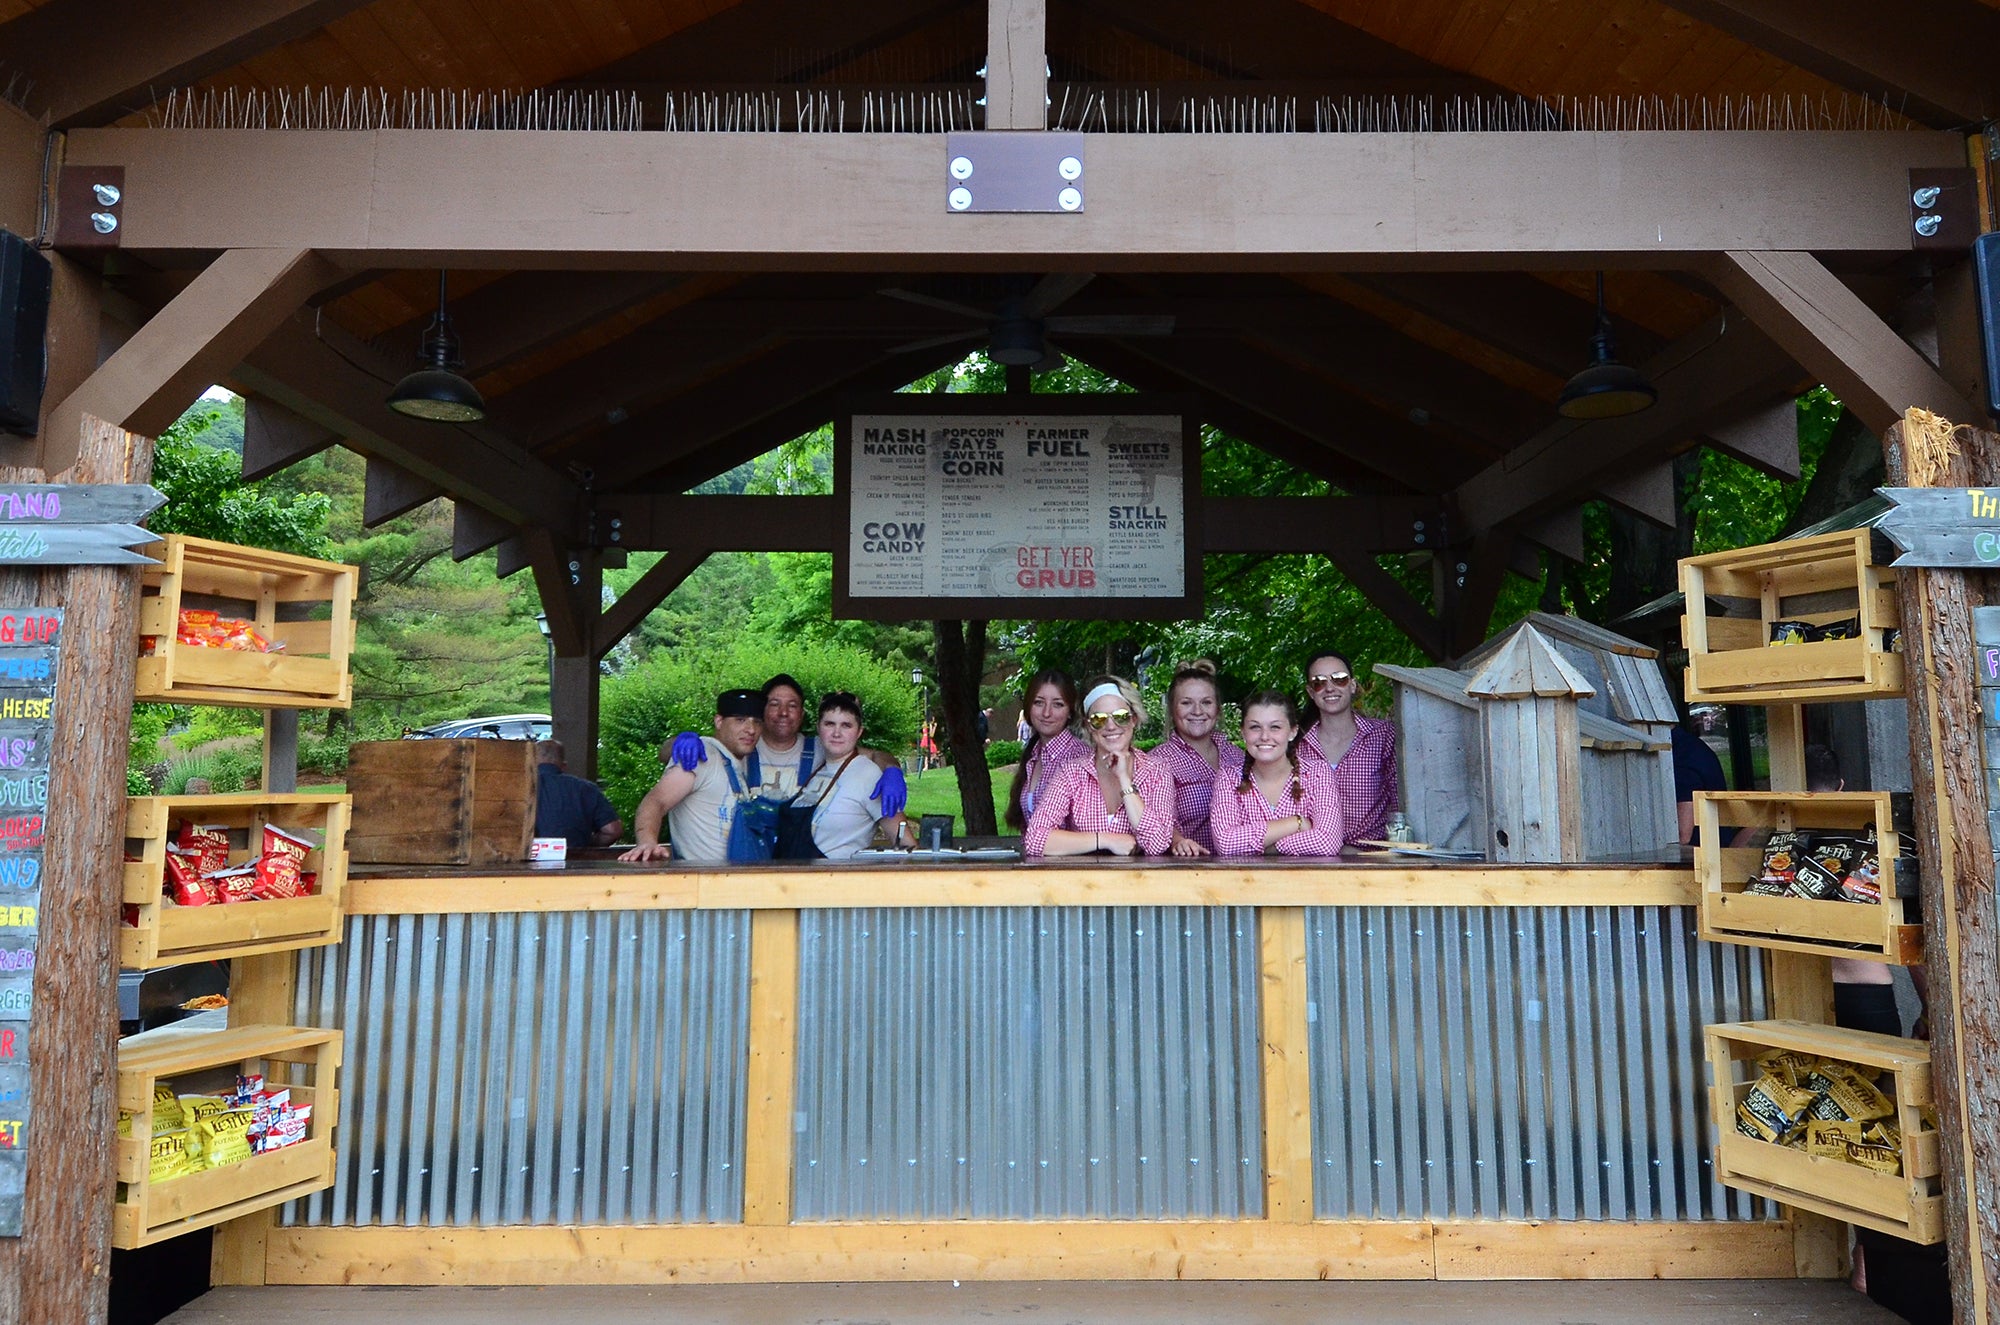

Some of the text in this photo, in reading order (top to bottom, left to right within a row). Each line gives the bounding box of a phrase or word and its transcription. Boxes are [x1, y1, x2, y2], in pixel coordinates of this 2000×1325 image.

[864, 428, 926, 443] MASH
[942, 428, 1004, 437] POPCORN
[1027, 429, 1089, 439] FARMER
[864, 444, 926, 455] MAKING
[950, 438, 997, 450] SAYS
[1027, 441, 1090, 457] FUEL
[1108, 443, 1170, 453] SWEETS
[943, 451, 1004, 460] SAVE THE
[942, 461, 1004, 476] CORN
[1967, 490, 2000, 518] TH
[1109, 506, 1167, 520] STILL
[863, 522, 925, 540] COW
[1109, 521, 1166, 529] SNACKIN
[863, 541, 925, 553] CANDY
[1974, 533, 2000, 562] G
[1017, 547, 1094, 568] GET YER
[1016, 570, 1096, 589] GRUB
[1, 615, 59, 642] & DIP
[0, 697, 53, 719] HEESE
[1753, 1090, 1771, 1105] SALT
[1746, 1098, 1769, 1118] PEPPER
[150, 1135, 185, 1157] ETTLE
[218, 1151, 252, 1167] CHEDDA
